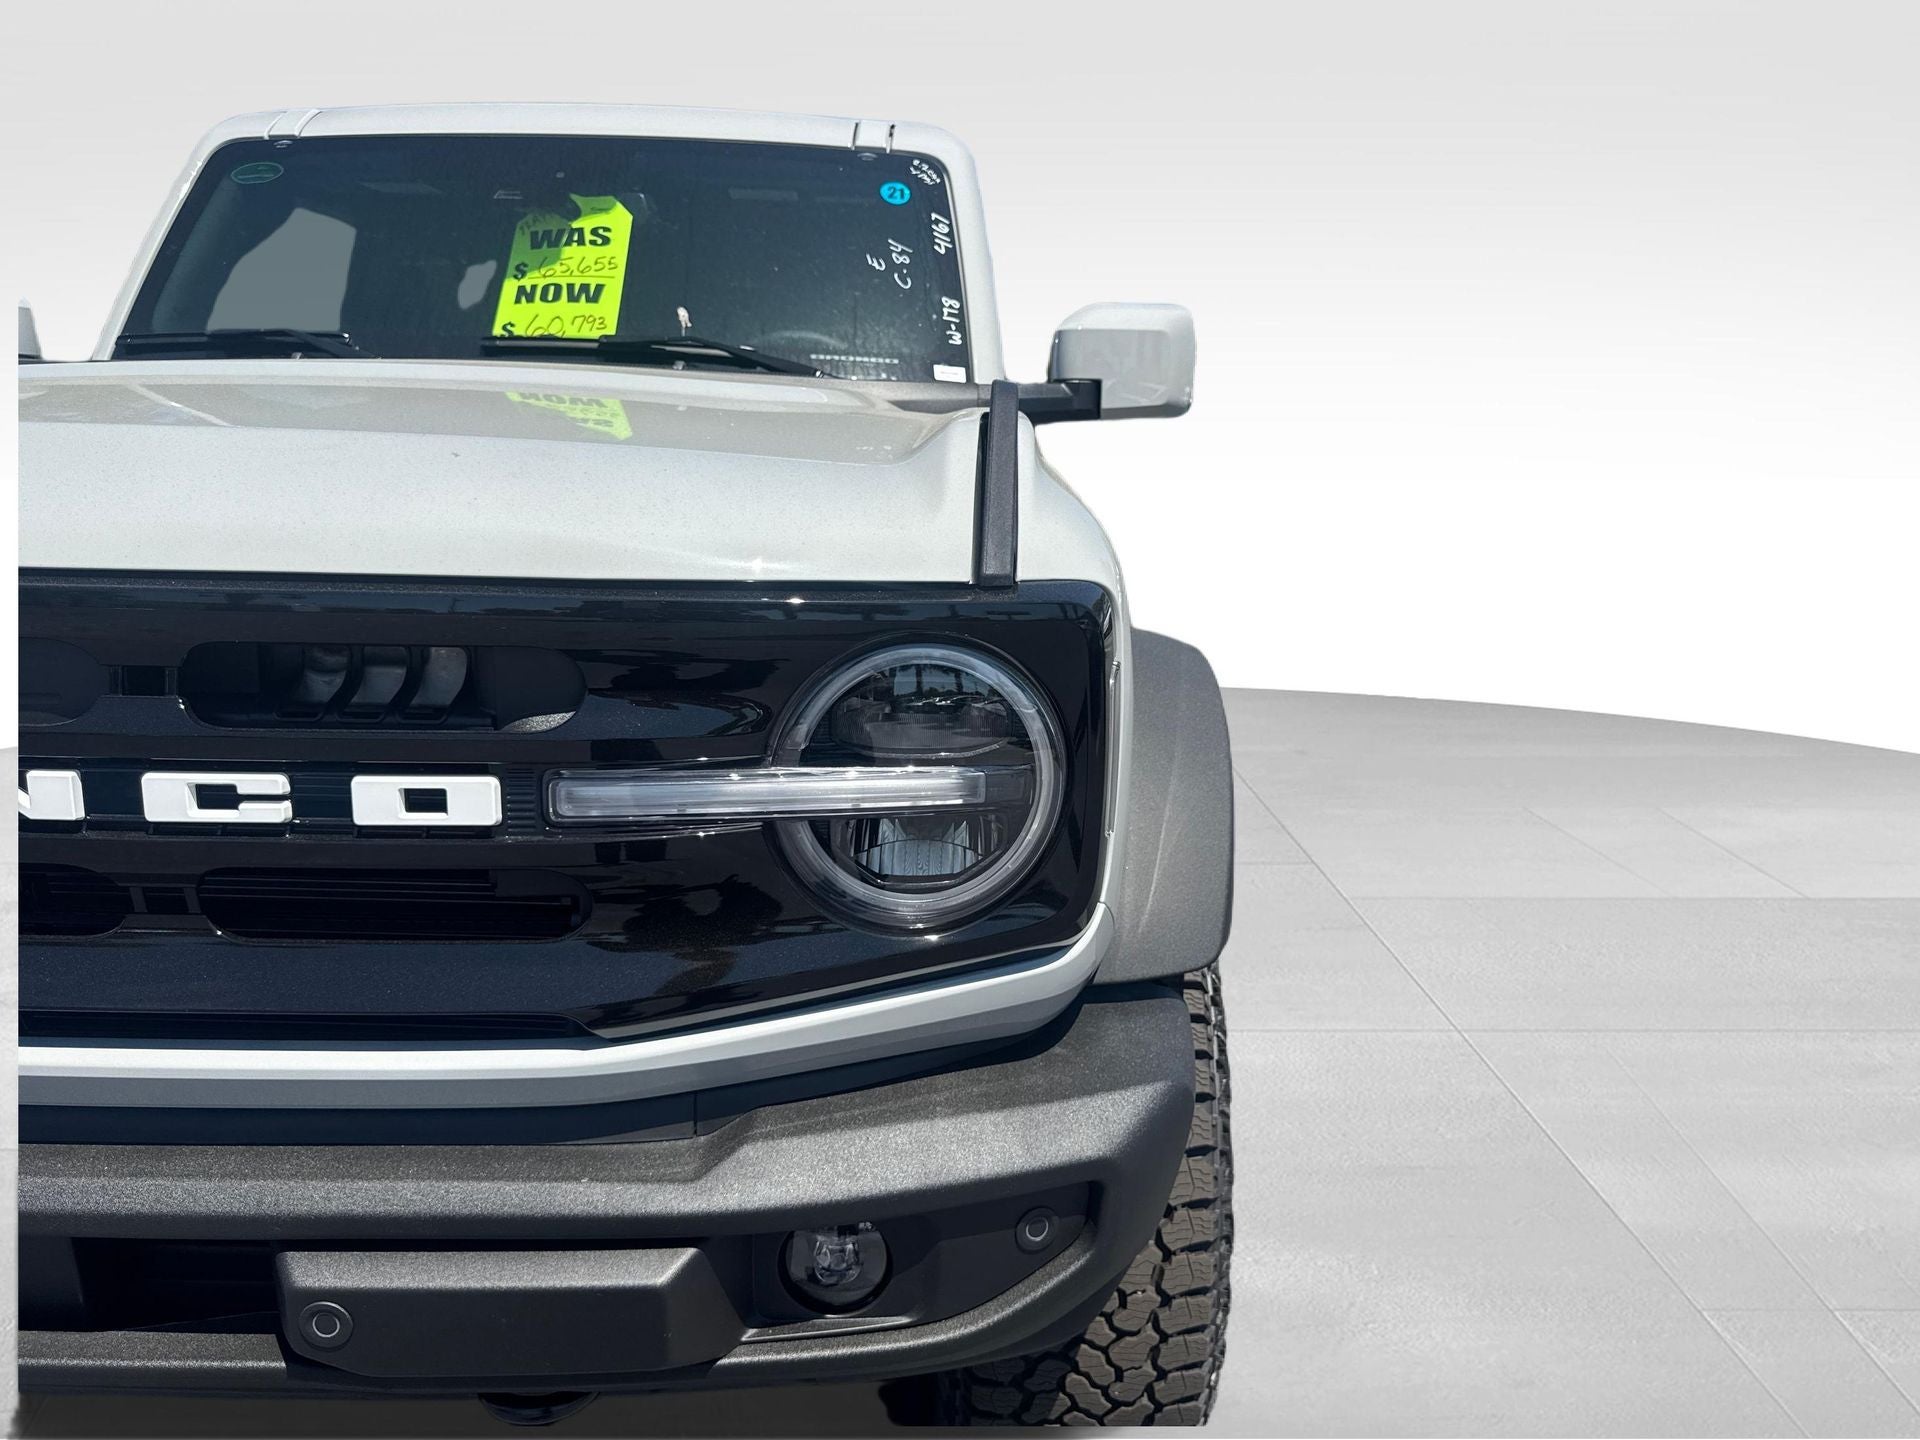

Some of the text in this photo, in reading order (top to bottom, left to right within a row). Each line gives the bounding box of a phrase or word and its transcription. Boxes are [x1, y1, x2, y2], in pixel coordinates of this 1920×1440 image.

[888, 186, 905, 200] 21
[530, 226, 612, 250] WAS
[930, 212, 953, 255] 4167
[514, 283, 606, 305] NOW
